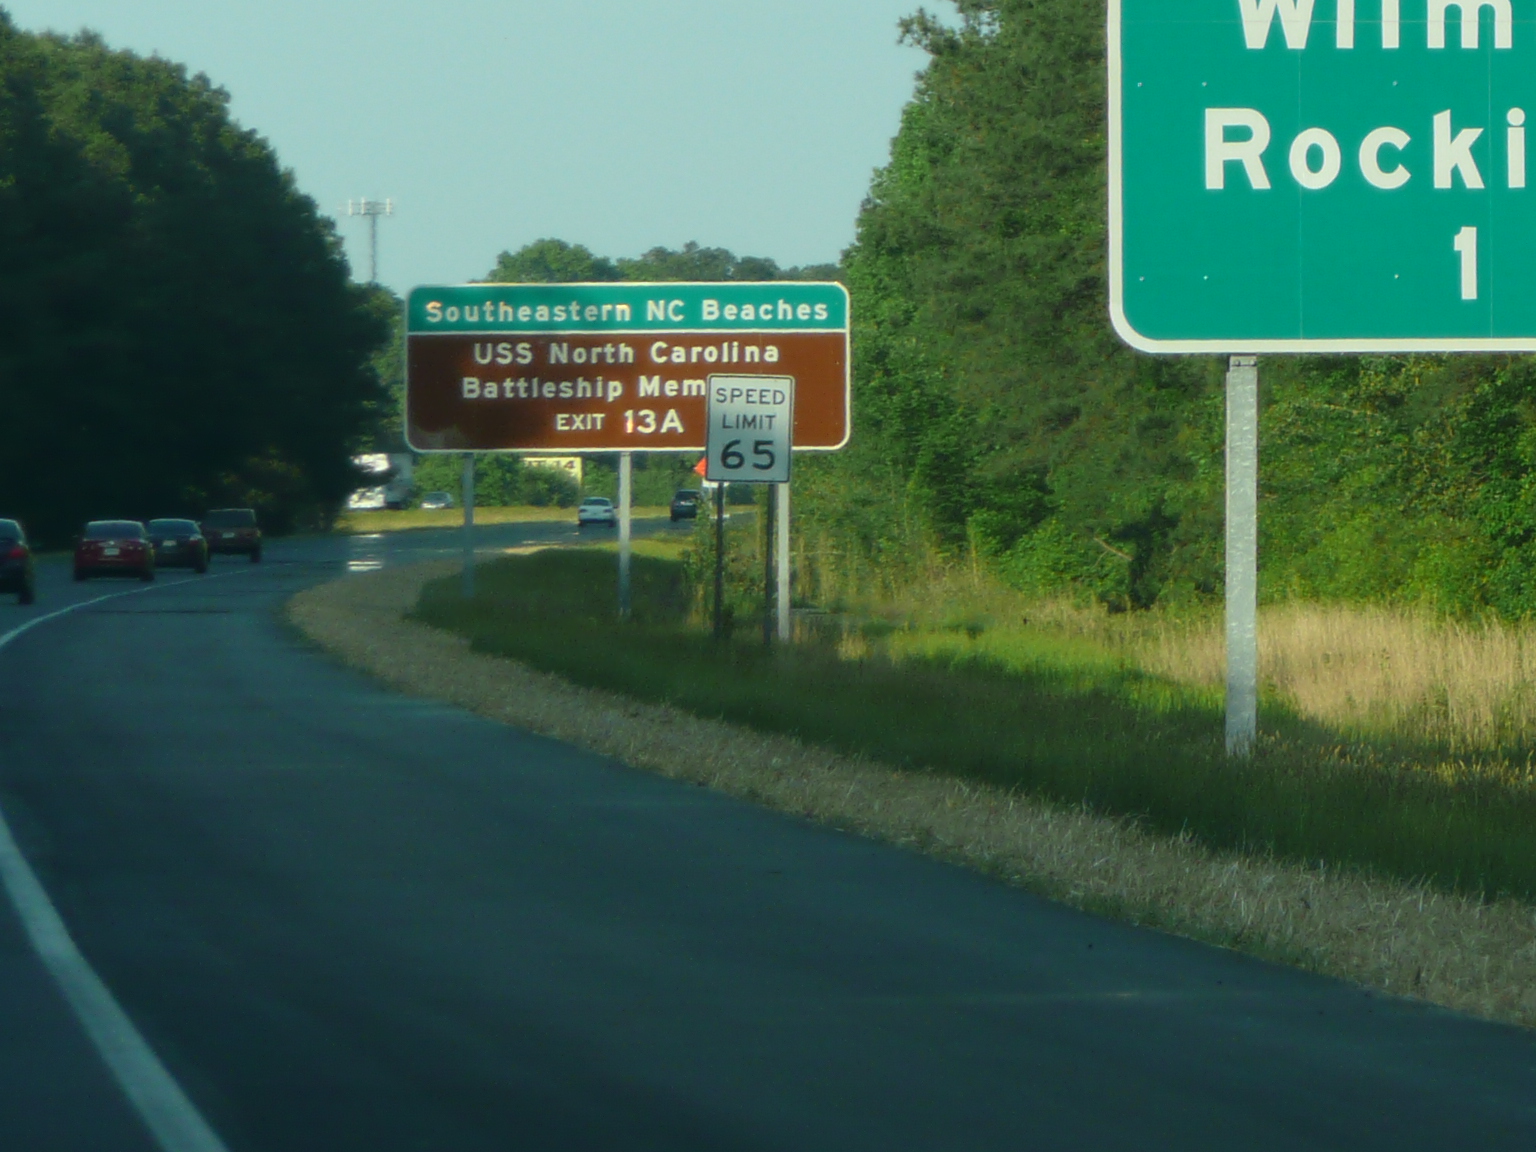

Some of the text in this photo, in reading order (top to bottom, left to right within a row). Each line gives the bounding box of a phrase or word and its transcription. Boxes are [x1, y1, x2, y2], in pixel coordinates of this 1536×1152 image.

[1454, 226, 1478, 300] 1
[425, 298, 829, 323] Southeastern NC Beaches
[473, 341, 780, 365] USS North Carolina
[461, 376, 624, 403] Battleship
[715, 387, 786, 405] SPEED
[555, 408, 685, 434] EXIT 13A
[721, 413, 777, 430] LIMIT
[720, 439, 776, 470] 65
